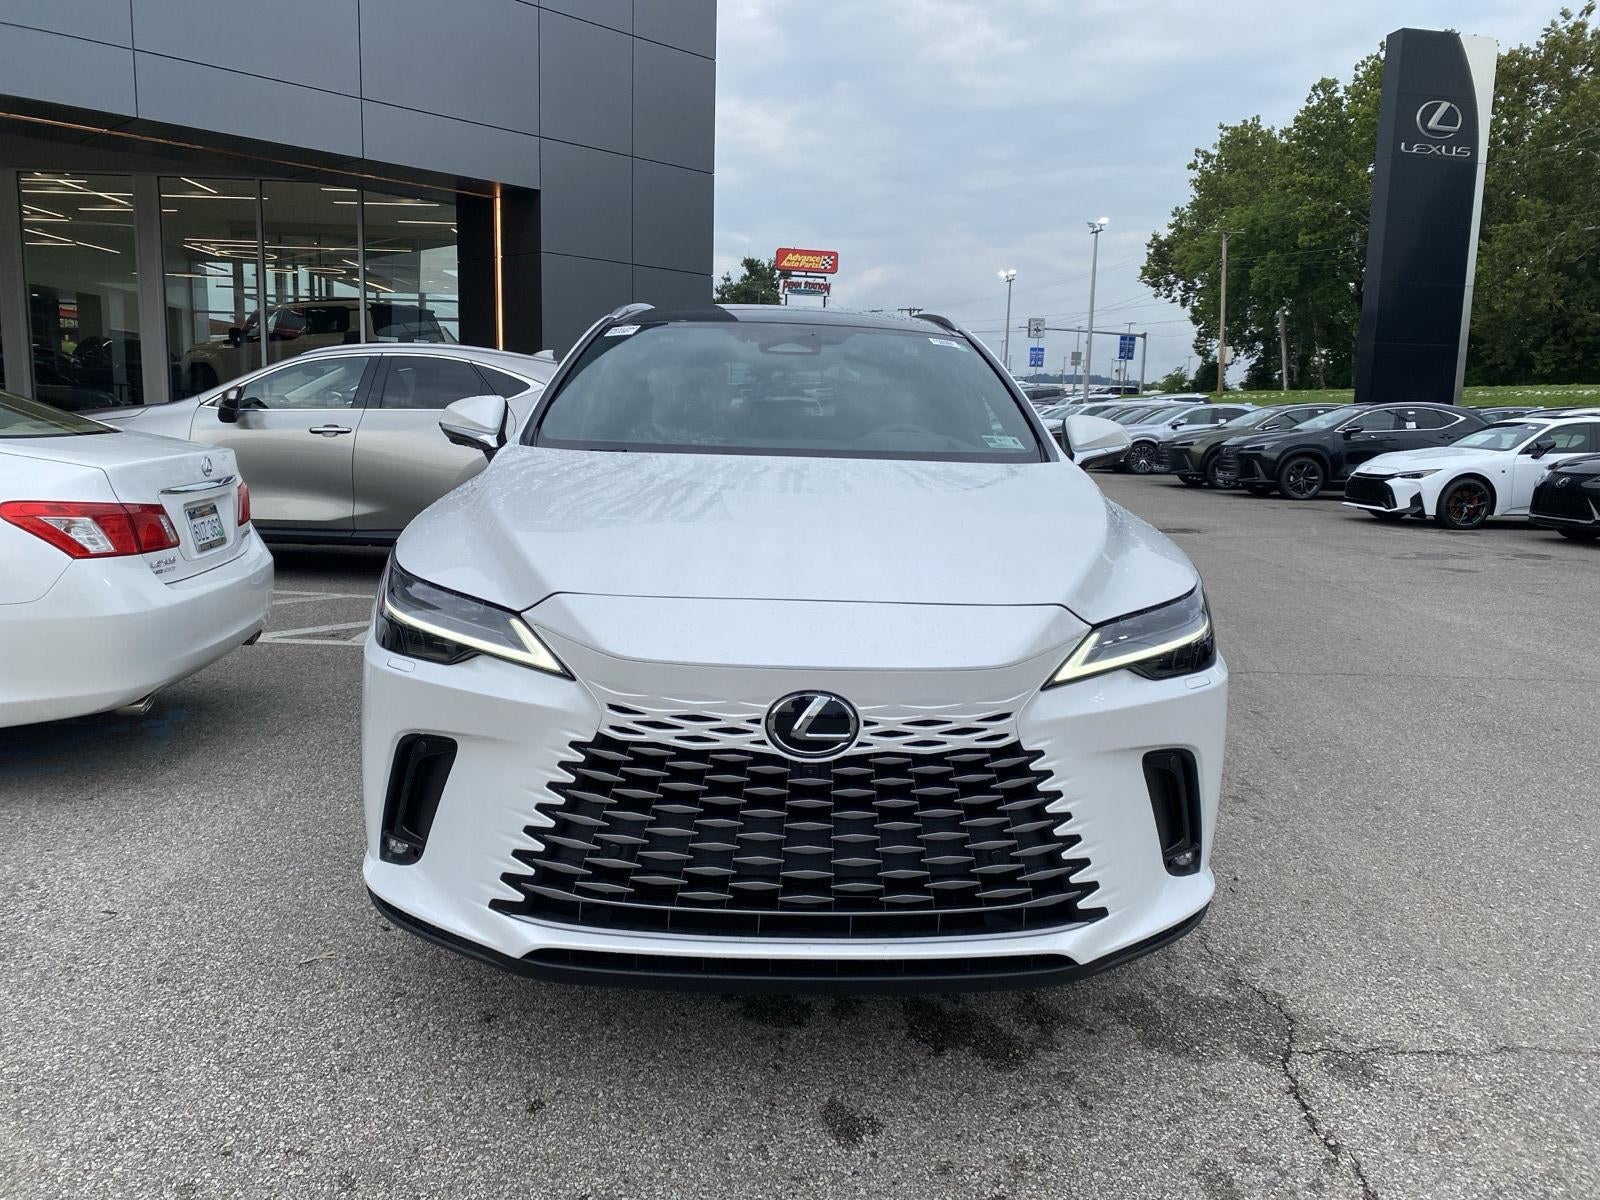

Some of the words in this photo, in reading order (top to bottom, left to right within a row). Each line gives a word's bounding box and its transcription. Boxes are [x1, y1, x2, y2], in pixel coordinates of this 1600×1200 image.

[1401, 142, 1471, 157] LEXUS
[786, 253, 821, 263] Advance
[804, 280, 831, 295] STATION
